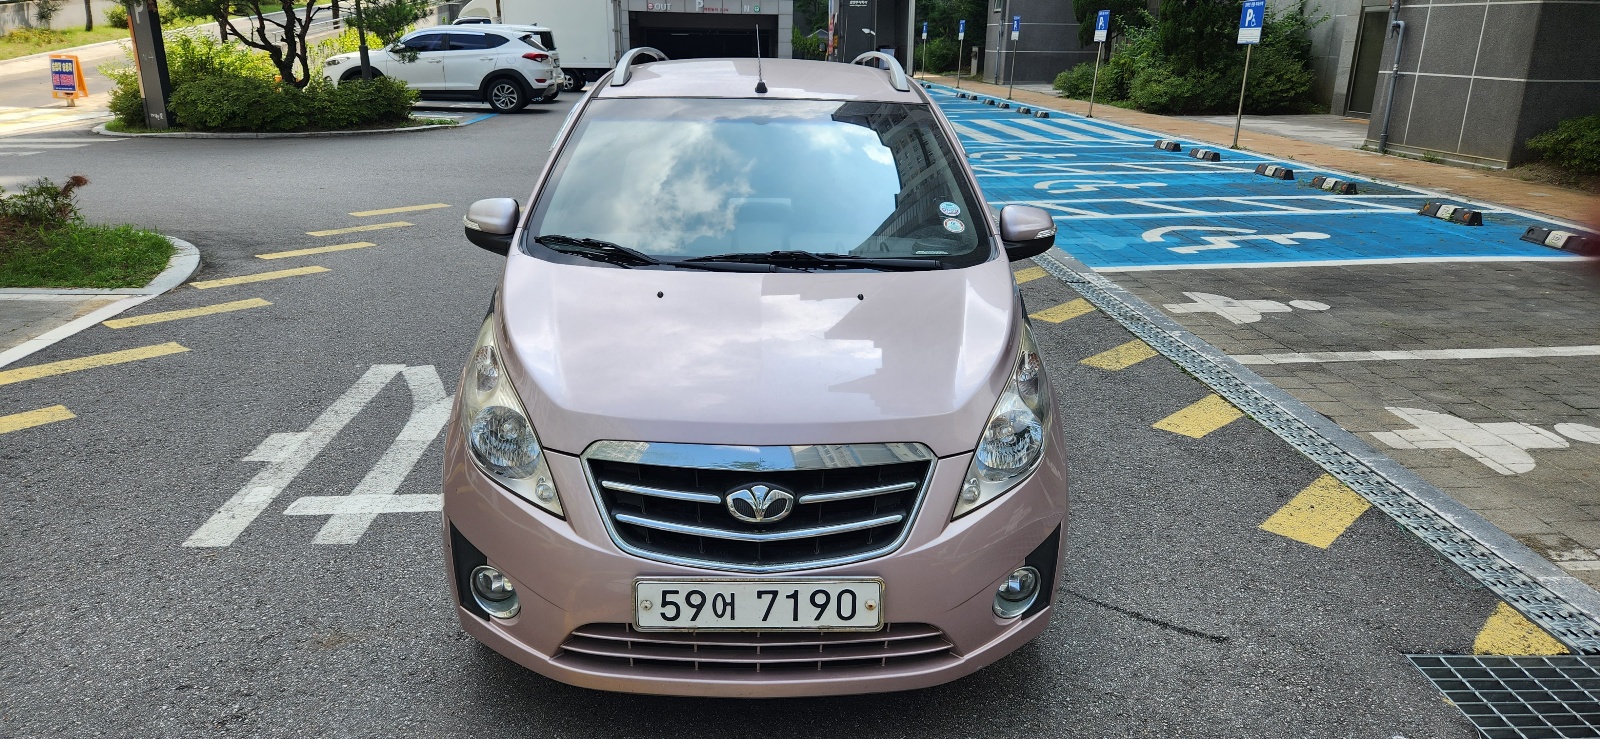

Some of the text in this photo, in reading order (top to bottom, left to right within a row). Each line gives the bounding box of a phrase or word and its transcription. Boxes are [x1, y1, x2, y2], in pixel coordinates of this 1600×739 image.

[654, 3, 672, 11] OUT
[695, 0, 704, 12] P
[1245, 8, 1254, 27] P
[659, 588, 858, 622] 59어 7190
